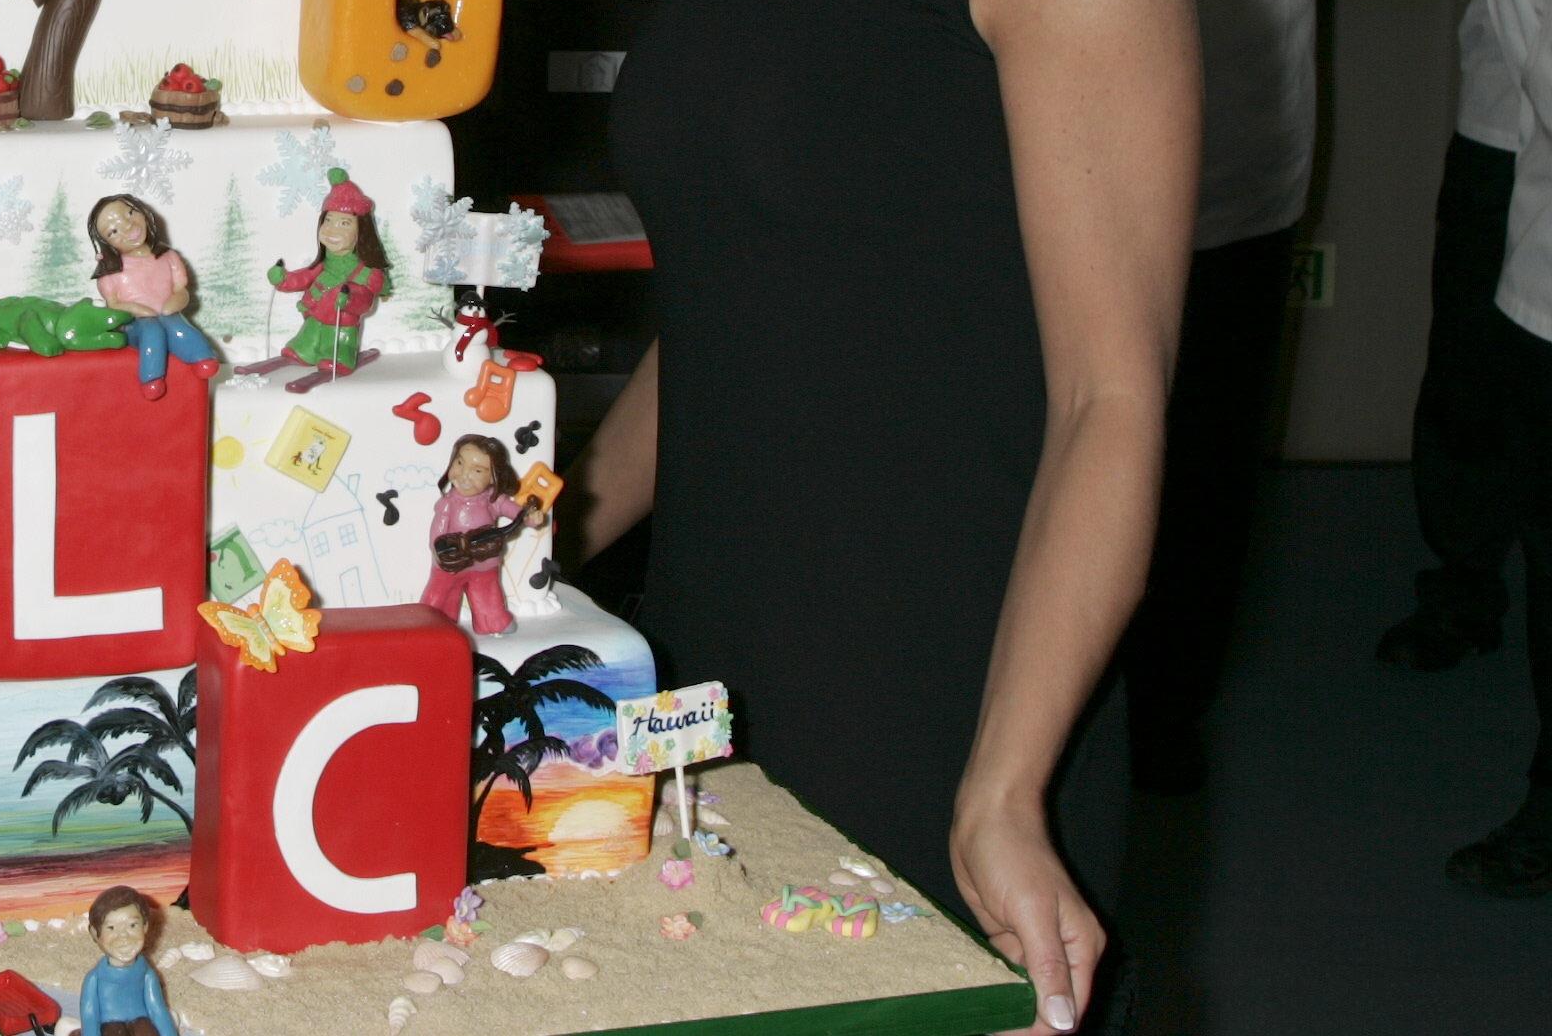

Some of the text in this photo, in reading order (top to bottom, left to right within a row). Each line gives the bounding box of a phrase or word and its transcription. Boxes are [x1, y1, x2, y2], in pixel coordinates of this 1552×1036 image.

[13, 413, 163, 639] L
[273, 685, 418, 913] C
[632, 702, 715, 736] Hawaii
